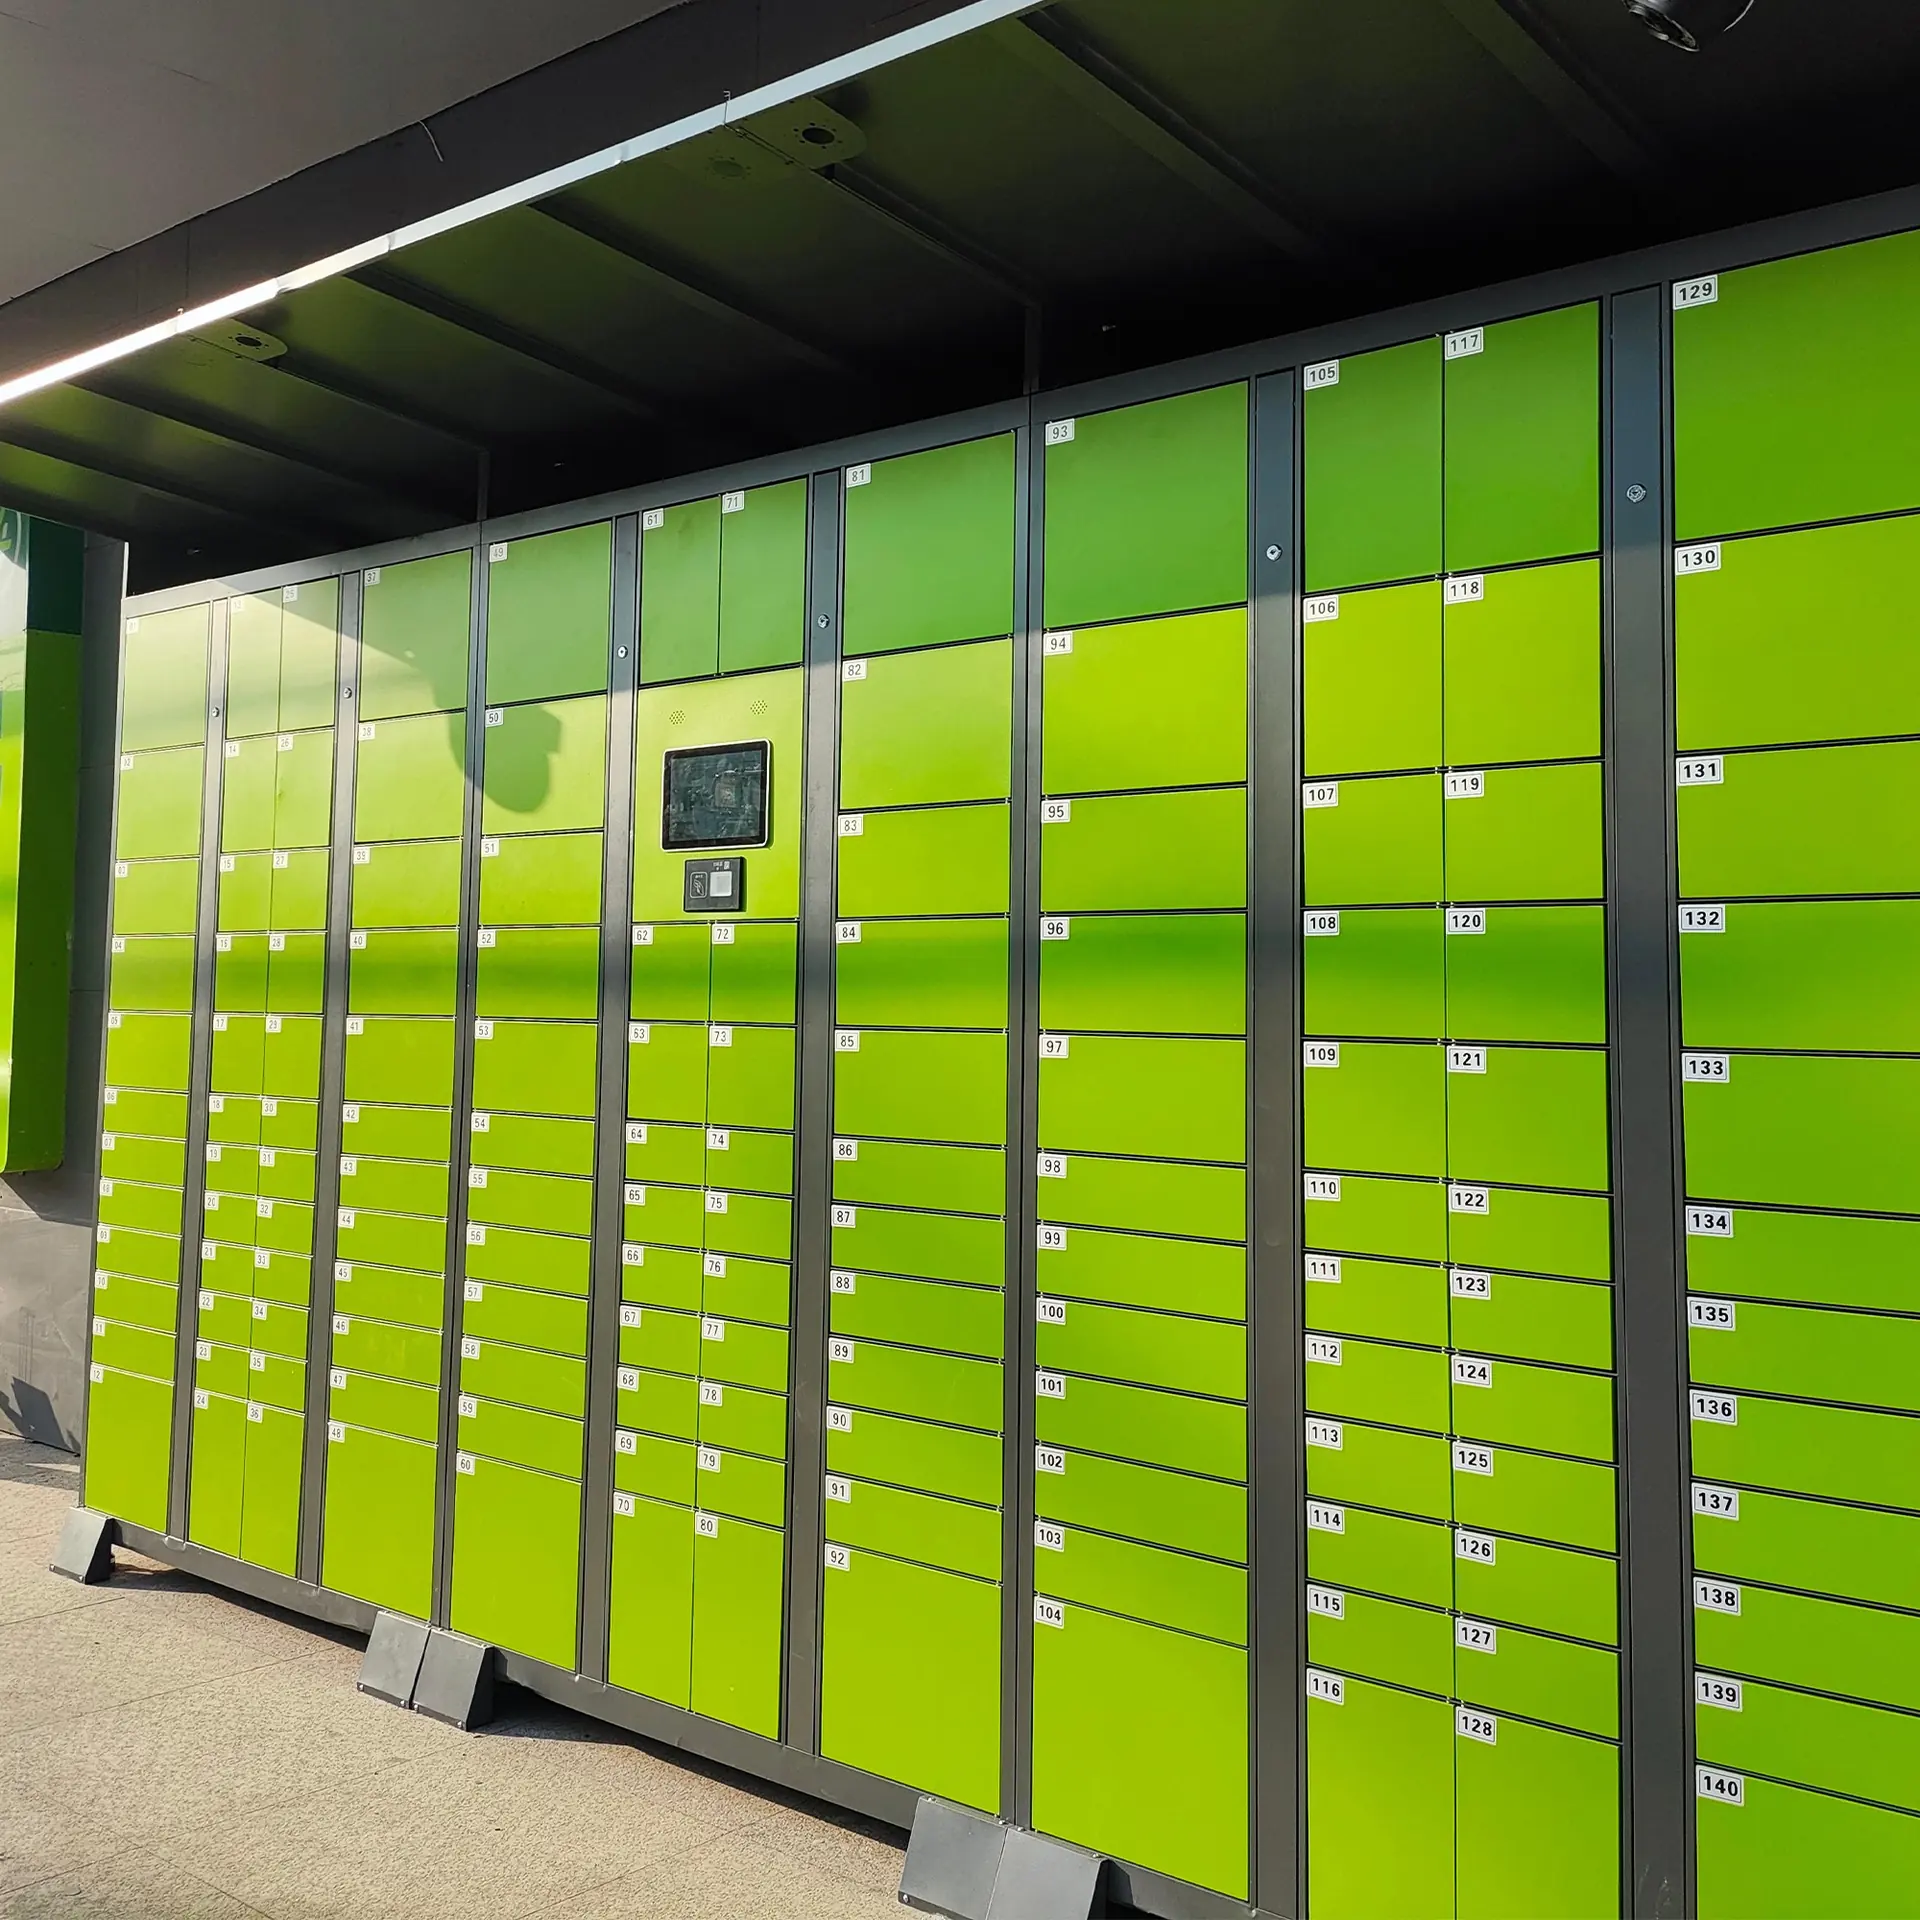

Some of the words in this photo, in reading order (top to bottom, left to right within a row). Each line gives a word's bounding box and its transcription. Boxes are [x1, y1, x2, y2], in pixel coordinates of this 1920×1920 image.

[1679, 282, 1713, 302] 129
[1450, 334, 1479, 353] 117
[1309, 365, 1336, 383] 105
[1052, 426, 1068, 440] 93
[851, 469, 866, 482] 81
[727, 496, 739, 509] 71
[647, 513, 659, 526] 61
[492, 546, 504, 558] 49
[1682, 549, 1716, 567] 130
[366, 571, 377, 583] 37
[1450, 581, 1479, 597] 118
[1309, 600, 1336, 615] 106
[1050, 637, 1066, 651] 94
[847, 663, 861, 677] 82
[488, 712, 499, 724] 50
[1683, 762, 1716, 778] 131
[1450, 777, 1479, 792] 119
[1308, 787, 1334, 802] 107
[1048, 805, 1065, 819] 95
[844, 819, 857, 832] 83
[356, 850, 366, 861] 39
[484, 843, 495, 854] 51
[1309, 916, 1336, 930] 108
[1452, 914, 1481, 928] 120
[1685, 911, 1720, 926] 132
[636, 929, 648, 941] 62
[716, 928, 729, 940] 72
[842, 926, 856, 939] 84
[1047, 921, 1064, 935] 96
[353, 935, 363, 946] 40
[481, 933, 492, 944] 52
[349, 1021, 359, 1031] 41
[478, 1025, 489, 1036] 53
[633, 1027, 645, 1039] 63
[714, 1030, 727, 1043] 73
[840, 1035, 855, 1048] 85
[1046, 1040, 1062, 1053] 97
[1309, 1047, 1336, 1061] 109
[1453, 1052, 1481, 1067] 121
[1689, 1060, 1724, 1075] 133
[346, 1109, 356, 1119] 42
[474, 1117, 486, 1129] 54
[631, 1128, 643, 1139] 64
[712, 1133, 725, 1146] 74
[838, 1143, 853, 1157] 86
[343, 1162, 353, 1172] 43
[1044, 1159, 1061, 1174] 98
[472, 1173, 484, 1184] 55
[1310, 1180, 1337, 1195] 110
[628, 1189, 641, 1201] 65
[1455, 1192, 1485, 1208] 122
[710, 1196, 723, 1209] 75
[342, 1215, 351, 1225] 44
[836, 1210, 850, 1223] 87
[1692, 1213, 1727, 1230] 134
[470, 1230, 481, 1242] 56
[1044, 1231, 1061, 1246] 99
[627, 1249, 639, 1262] 66
[338, 1267, 348, 1278] 45
[708, 1259, 721, 1273] 76
[1310, 1261, 1336, 1276] 111
[835, 1275, 850, 1290] 88
[1455, 1276, 1486, 1292] 123
[467, 1286, 478, 1298] 57
[624, 1310, 636, 1323] 67
[1042, 1304, 1064, 1319] 100
[1694, 1305, 1729, 1323] 135
[335, 1320, 346, 1331] 46
[706, 1323, 719, 1336] 77
[464, 1343, 476, 1355] 58
[834, 1344, 849, 1358] 89
[1311, 1342, 1338, 1359] 112
[1457, 1363, 1488, 1381] 124
[333, 1374, 343, 1385] 47
[622, 1373, 635, 1387] 68
[1041, 1378, 1062, 1393] 101
[704, 1388, 717, 1401] 78
[462, 1401, 473, 1414] 59
[1696, 1398, 1732, 1418] 136
[832, 1412, 847, 1427] 90
[331, 1427, 342, 1439] 48
[1312, 1426, 1338, 1443] 113
[620, 1436, 632, 1450] 69
[460, 1458, 471, 1471] 60
[703, 1453, 716, 1467] 79
[1040, 1453, 1063, 1469] 102
[1458, 1450, 1488, 1468] 125
[831, 1482, 845, 1497] 91
[617, 1498, 630, 1512] 70
[1698, 1491, 1733, 1512] 137
[1313, 1509, 1341, 1527] 114
[700, 1518, 713, 1533] 80
[1039, 1528, 1061, 1545] 103
[1460, 1538, 1491, 1557] 126
[830, 1550, 845, 1566] 92
[1313, 1593, 1340, 1612] 115
[1700, 1586, 1736, 1607] 138
[1039, 1604, 1062, 1622] 104
[1461, 1626, 1491, 1645] 127
[1313, 1677, 1340, 1697] 116
[1701, 1679, 1737, 1703] 139
[1462, 1715, 1492, 1737] 128
[1703, 1774, 1739, 1798] 140
